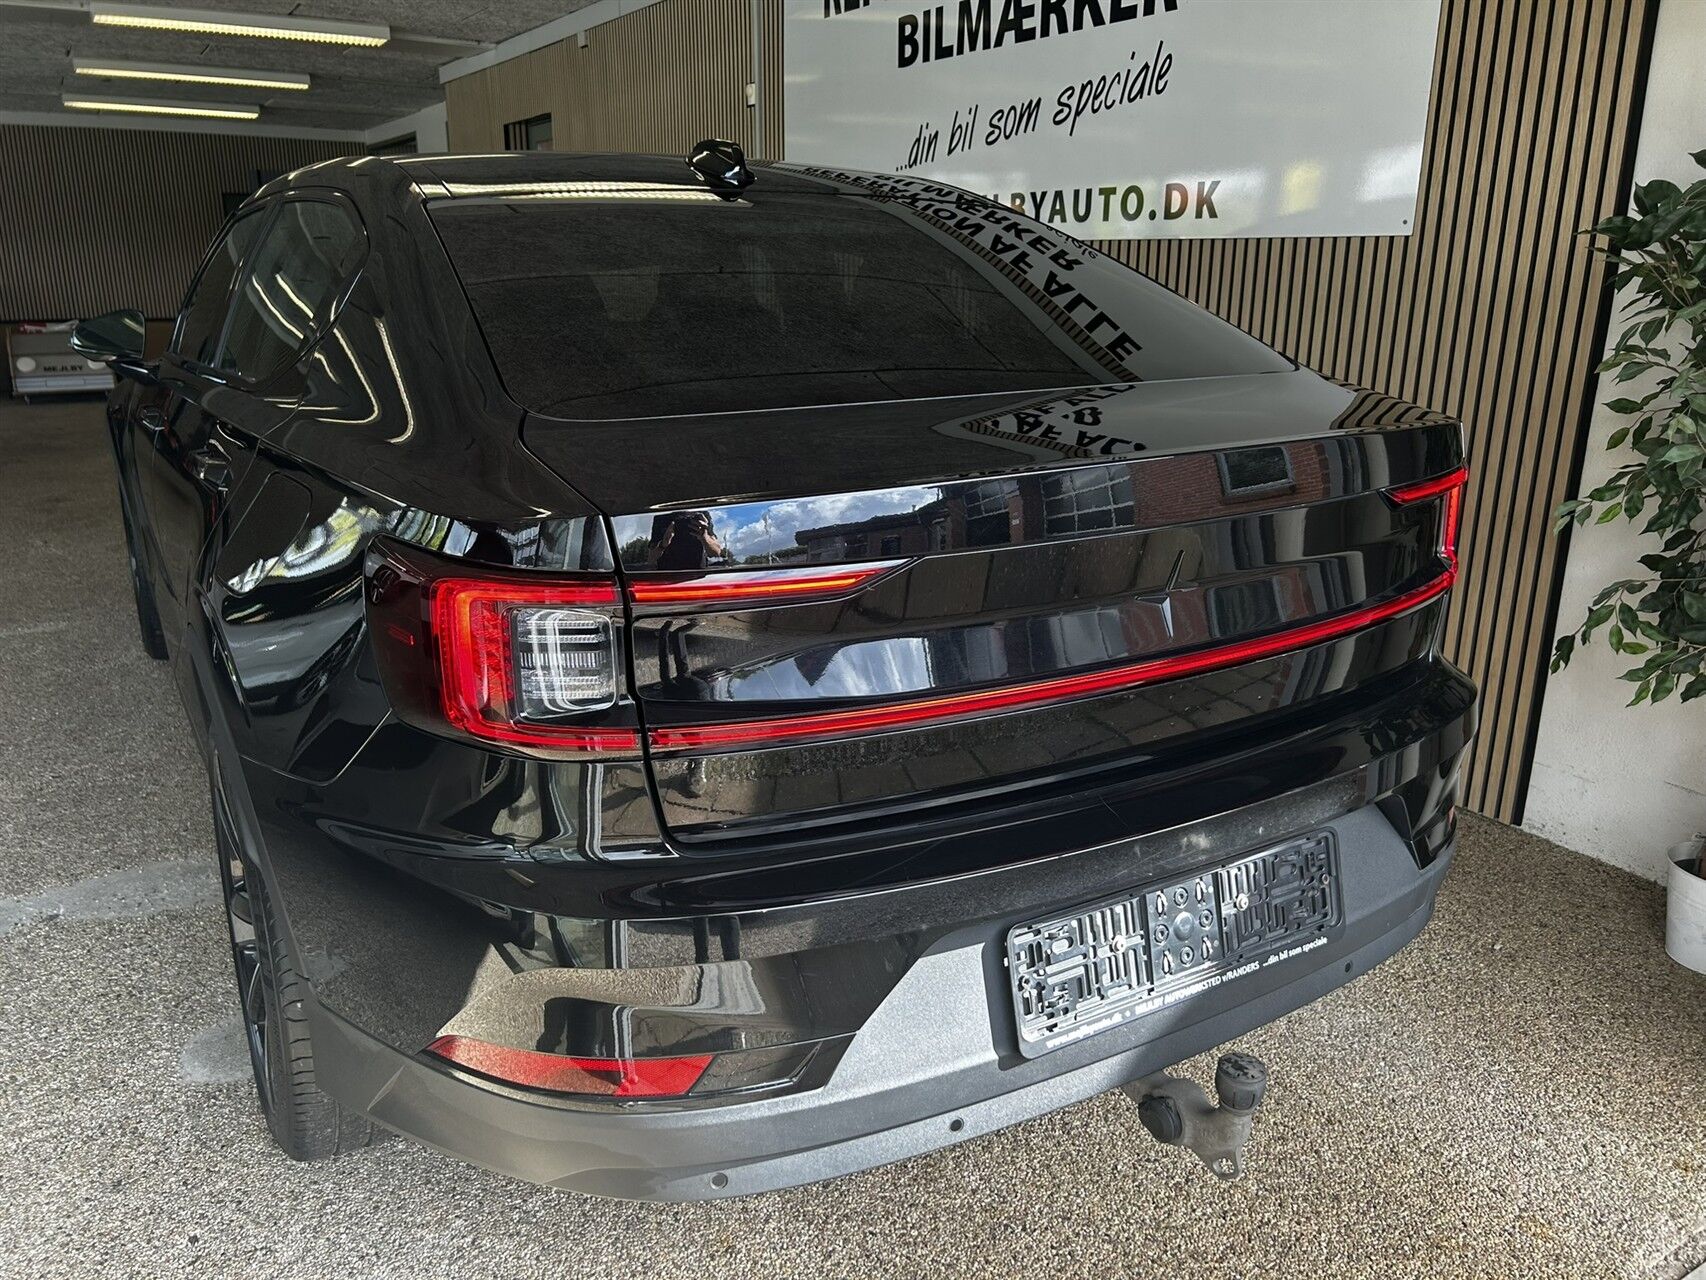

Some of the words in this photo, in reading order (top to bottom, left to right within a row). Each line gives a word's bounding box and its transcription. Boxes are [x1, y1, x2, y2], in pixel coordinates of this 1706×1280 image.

[947, 104, 978, 156] bil
[985, 97, 1041, 145] som
[1053, 40, 1173, 136] speciale
